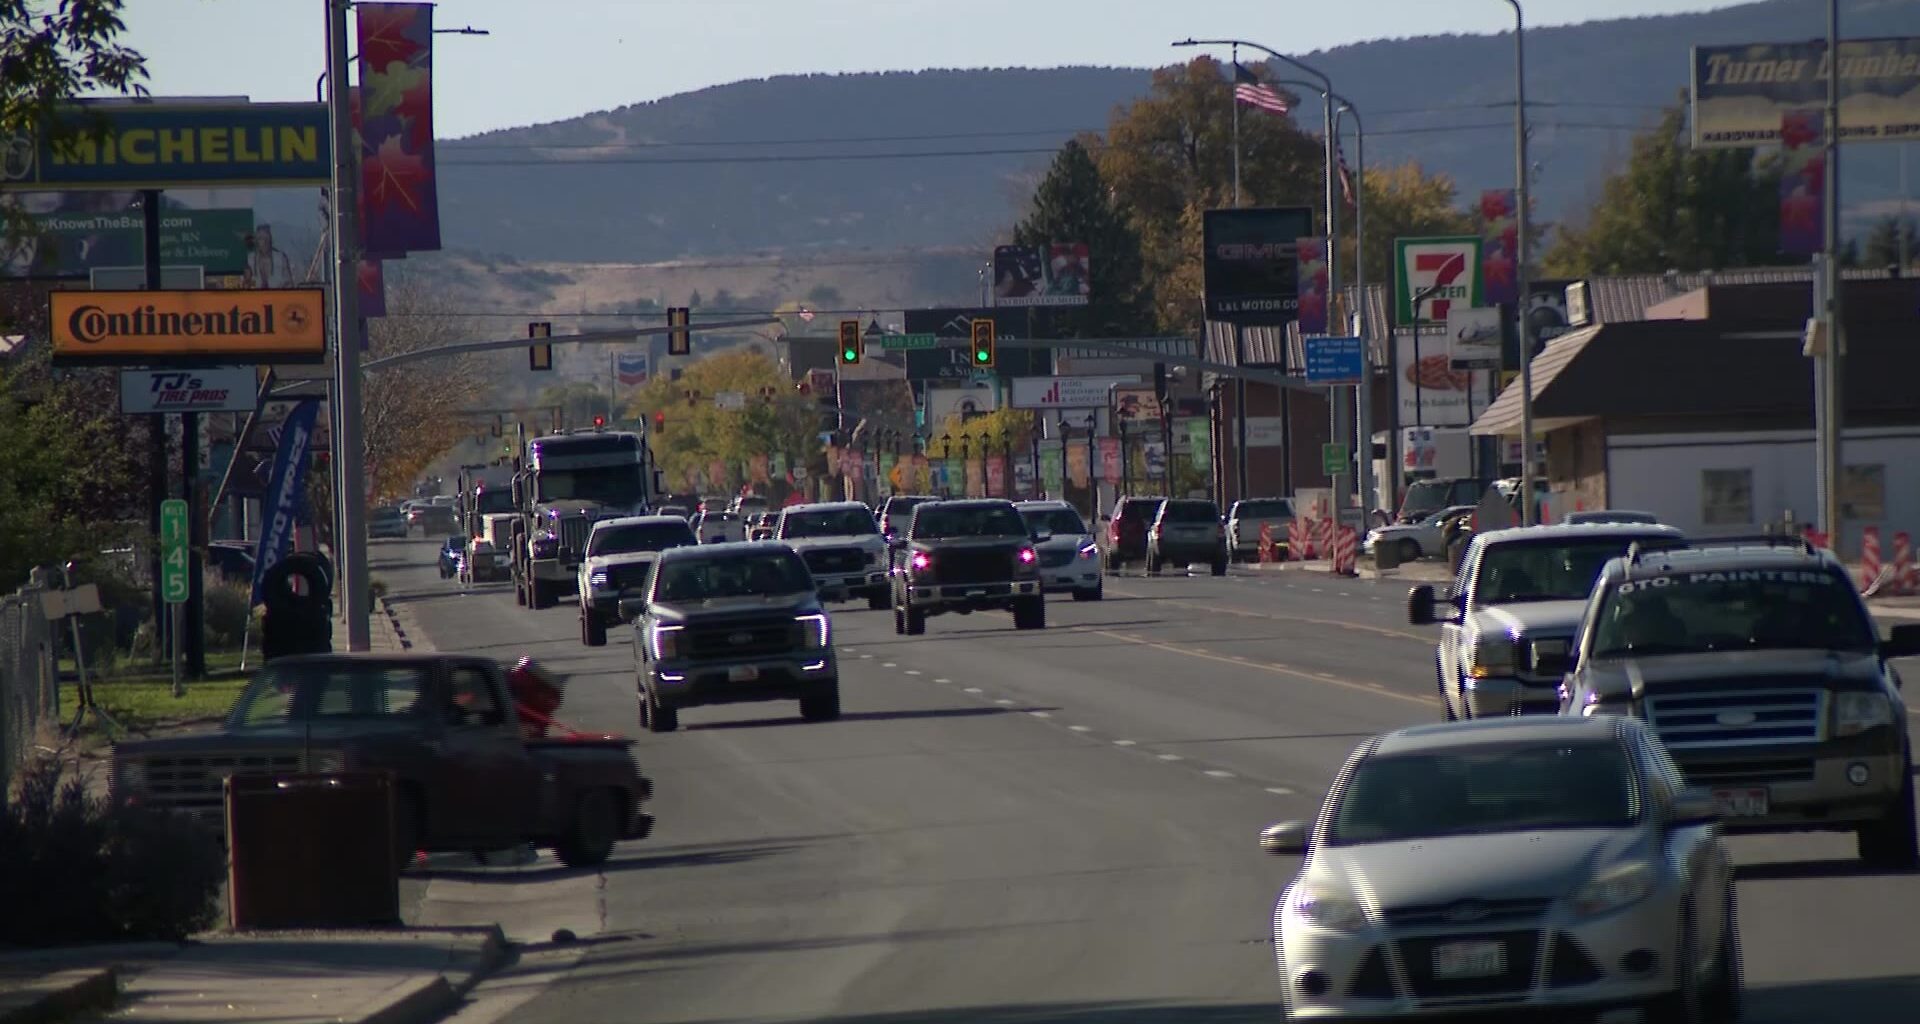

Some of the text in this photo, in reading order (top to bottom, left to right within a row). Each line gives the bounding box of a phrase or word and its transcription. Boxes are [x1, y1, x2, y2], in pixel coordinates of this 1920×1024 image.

[1705, 54, 1807, 85] Turner
[53, 127, 316, 164] MICHELIN
[1216, 243, 1297, 260] GMC
[1241, 300, 1281, 311] MOTOR
[69, 305, 275, 343] Continental
[150, 372, 203, 392] TJ's
[156, 390, 188, 407] TIRE
[1689, 569, 1833, 585] PAINTERS
